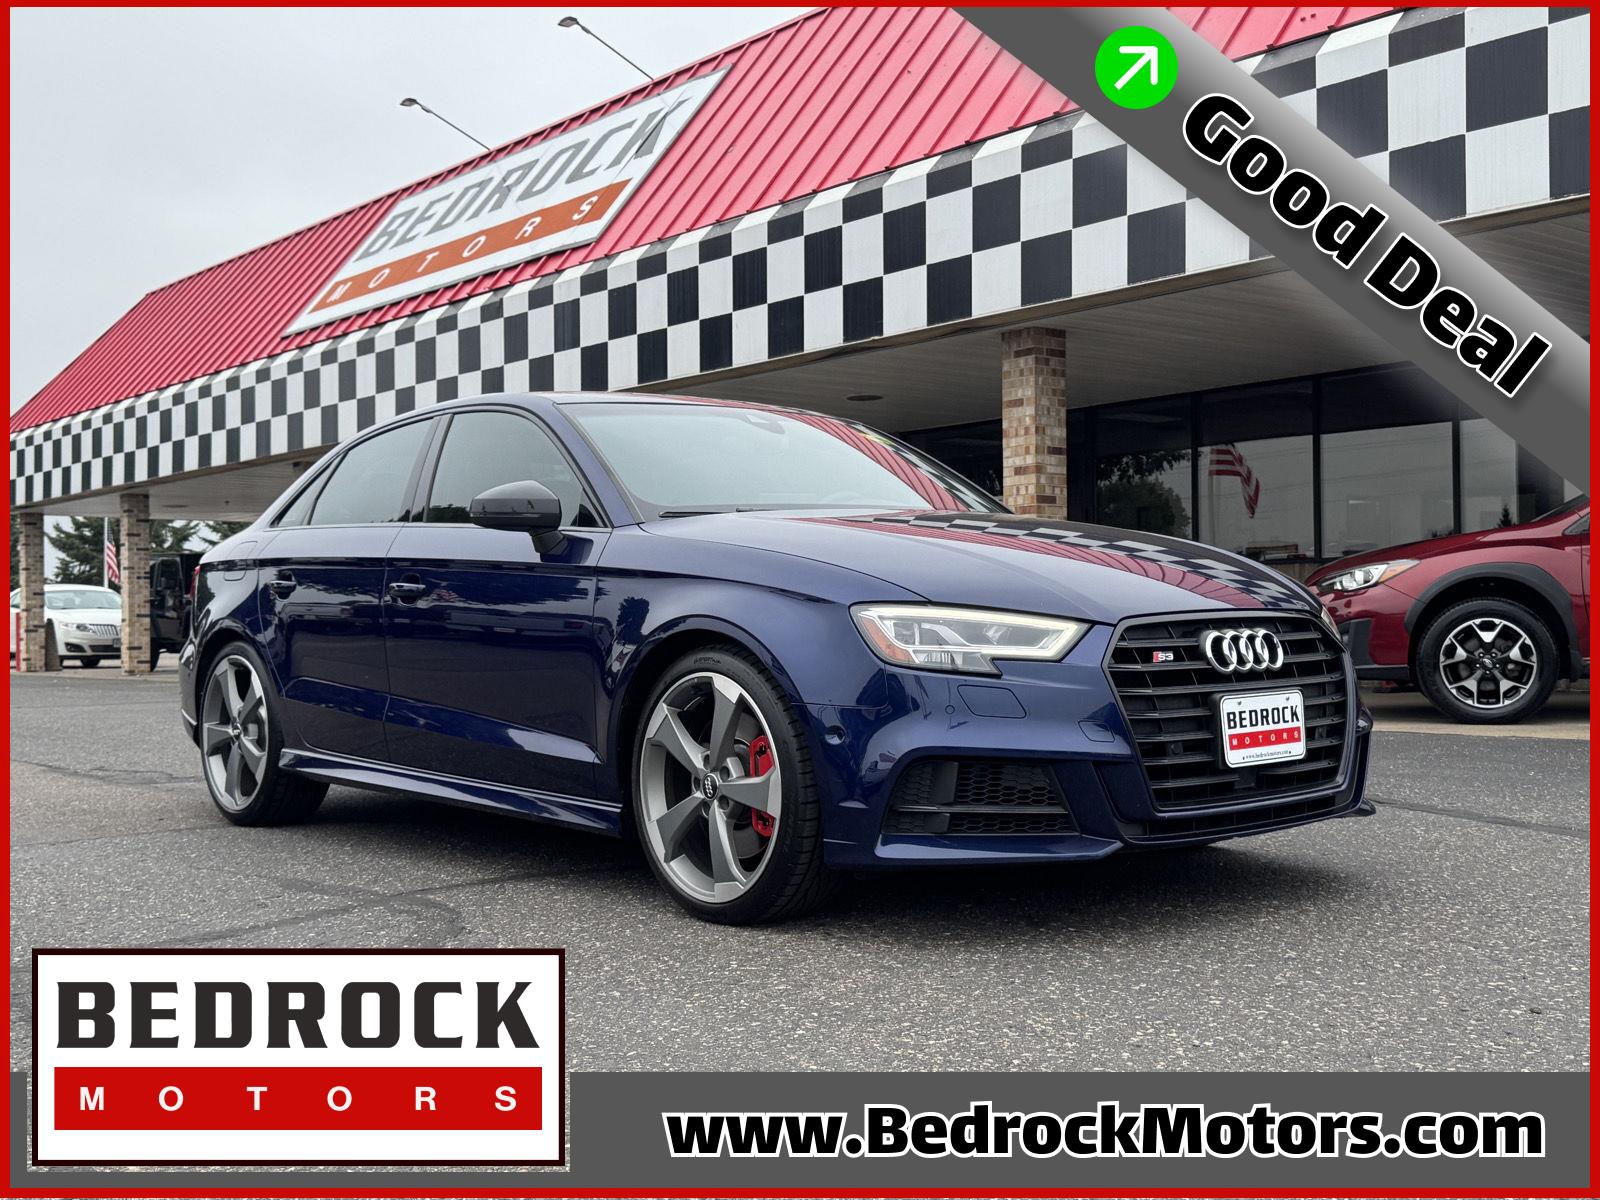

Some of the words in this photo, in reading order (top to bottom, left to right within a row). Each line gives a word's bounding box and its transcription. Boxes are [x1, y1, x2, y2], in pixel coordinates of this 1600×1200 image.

[354, 96, 694, 262] BEDROCK
[327, 195, 598, 303] MOTORS
[1226, 705, 1300, 730] BEDROCK
[1232, 731, 1299, 746] MOTORS
